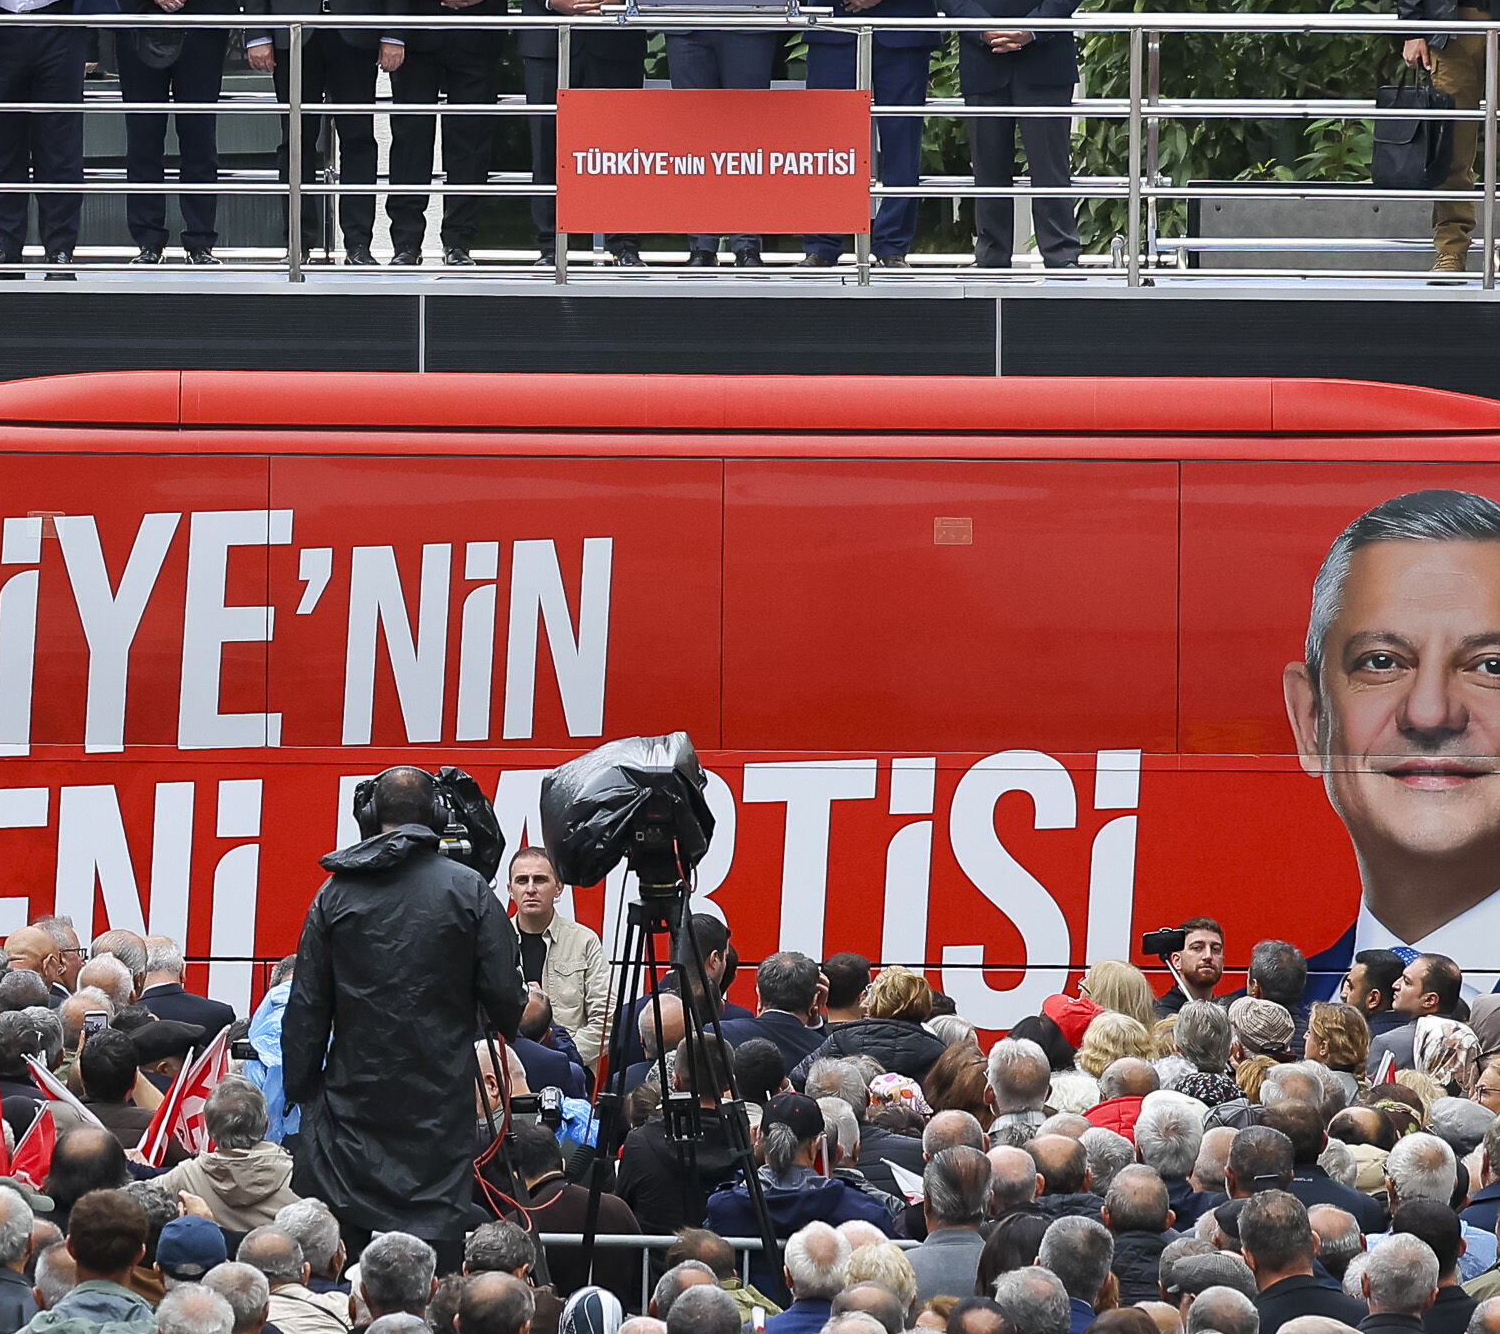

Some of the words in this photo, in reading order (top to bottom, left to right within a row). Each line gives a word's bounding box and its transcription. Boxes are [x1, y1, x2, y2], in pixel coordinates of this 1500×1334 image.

[572, 147, 705, 176] TÜRKİYE'NİN
[710, 147, 764, 176] YENİ
[769, 147, 857, 176] PARTİSİ
